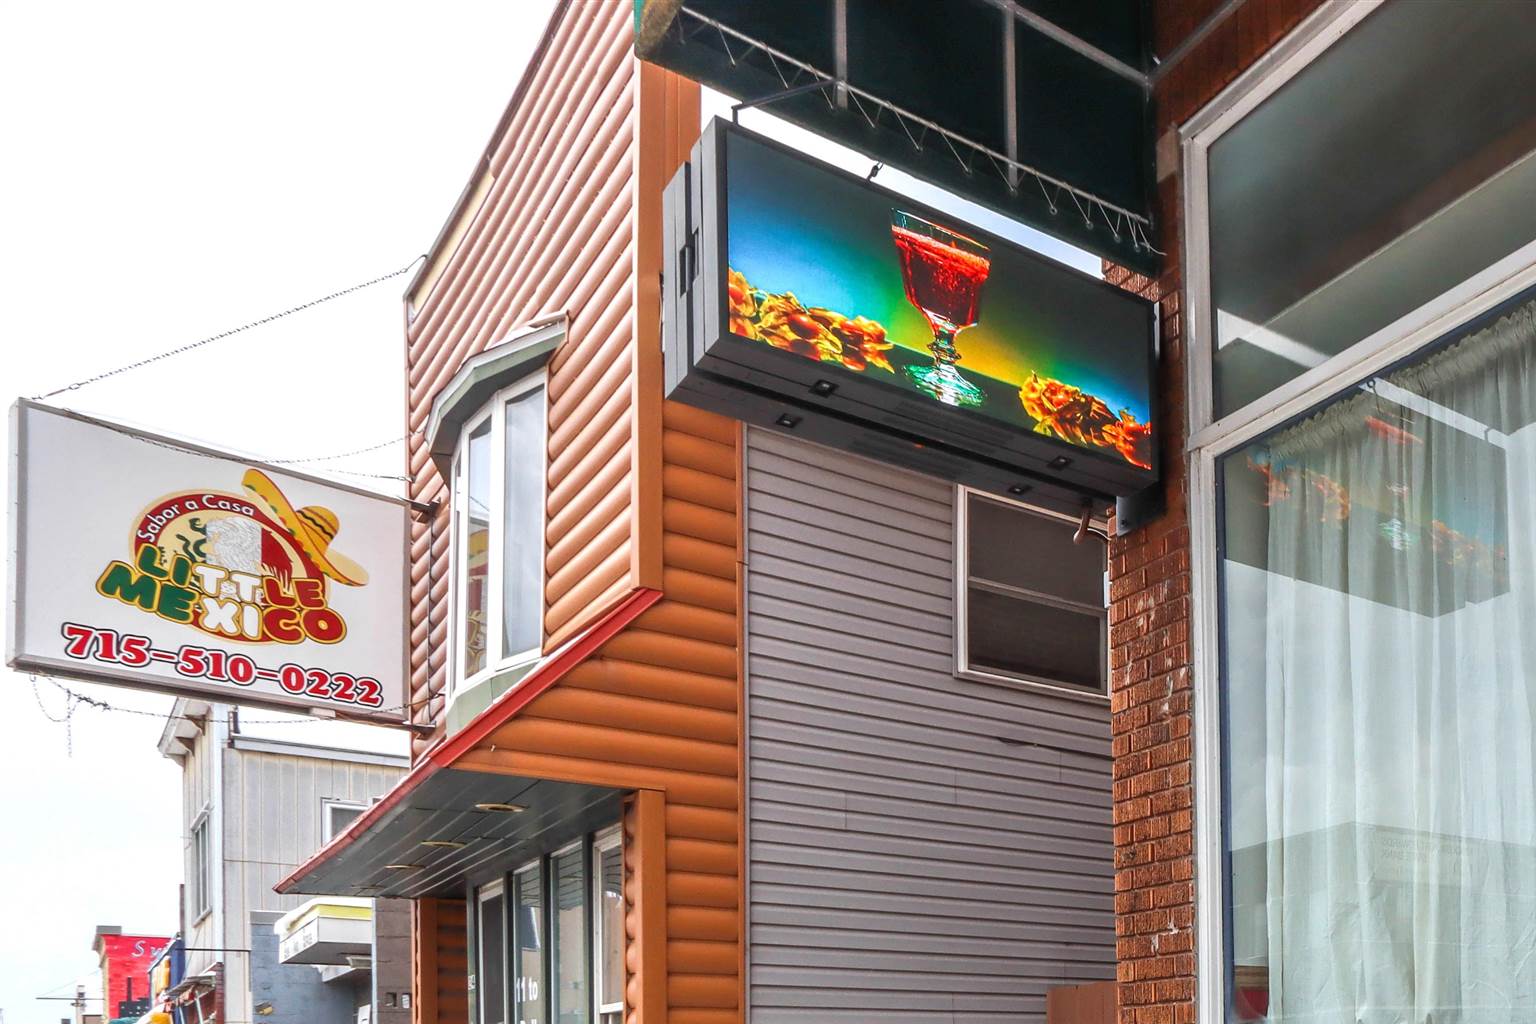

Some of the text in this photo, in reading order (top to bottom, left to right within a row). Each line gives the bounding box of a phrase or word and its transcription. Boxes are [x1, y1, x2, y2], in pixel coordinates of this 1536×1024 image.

[137, 495, 254, 542] Sabor a Casa
[95, 560, 348, 645] MEXICO
[137, 543, 328, 610] LITTLE
[62, 623, 383, 707] 715-510-0222
[516, 977, 538, 1003] 11 to
